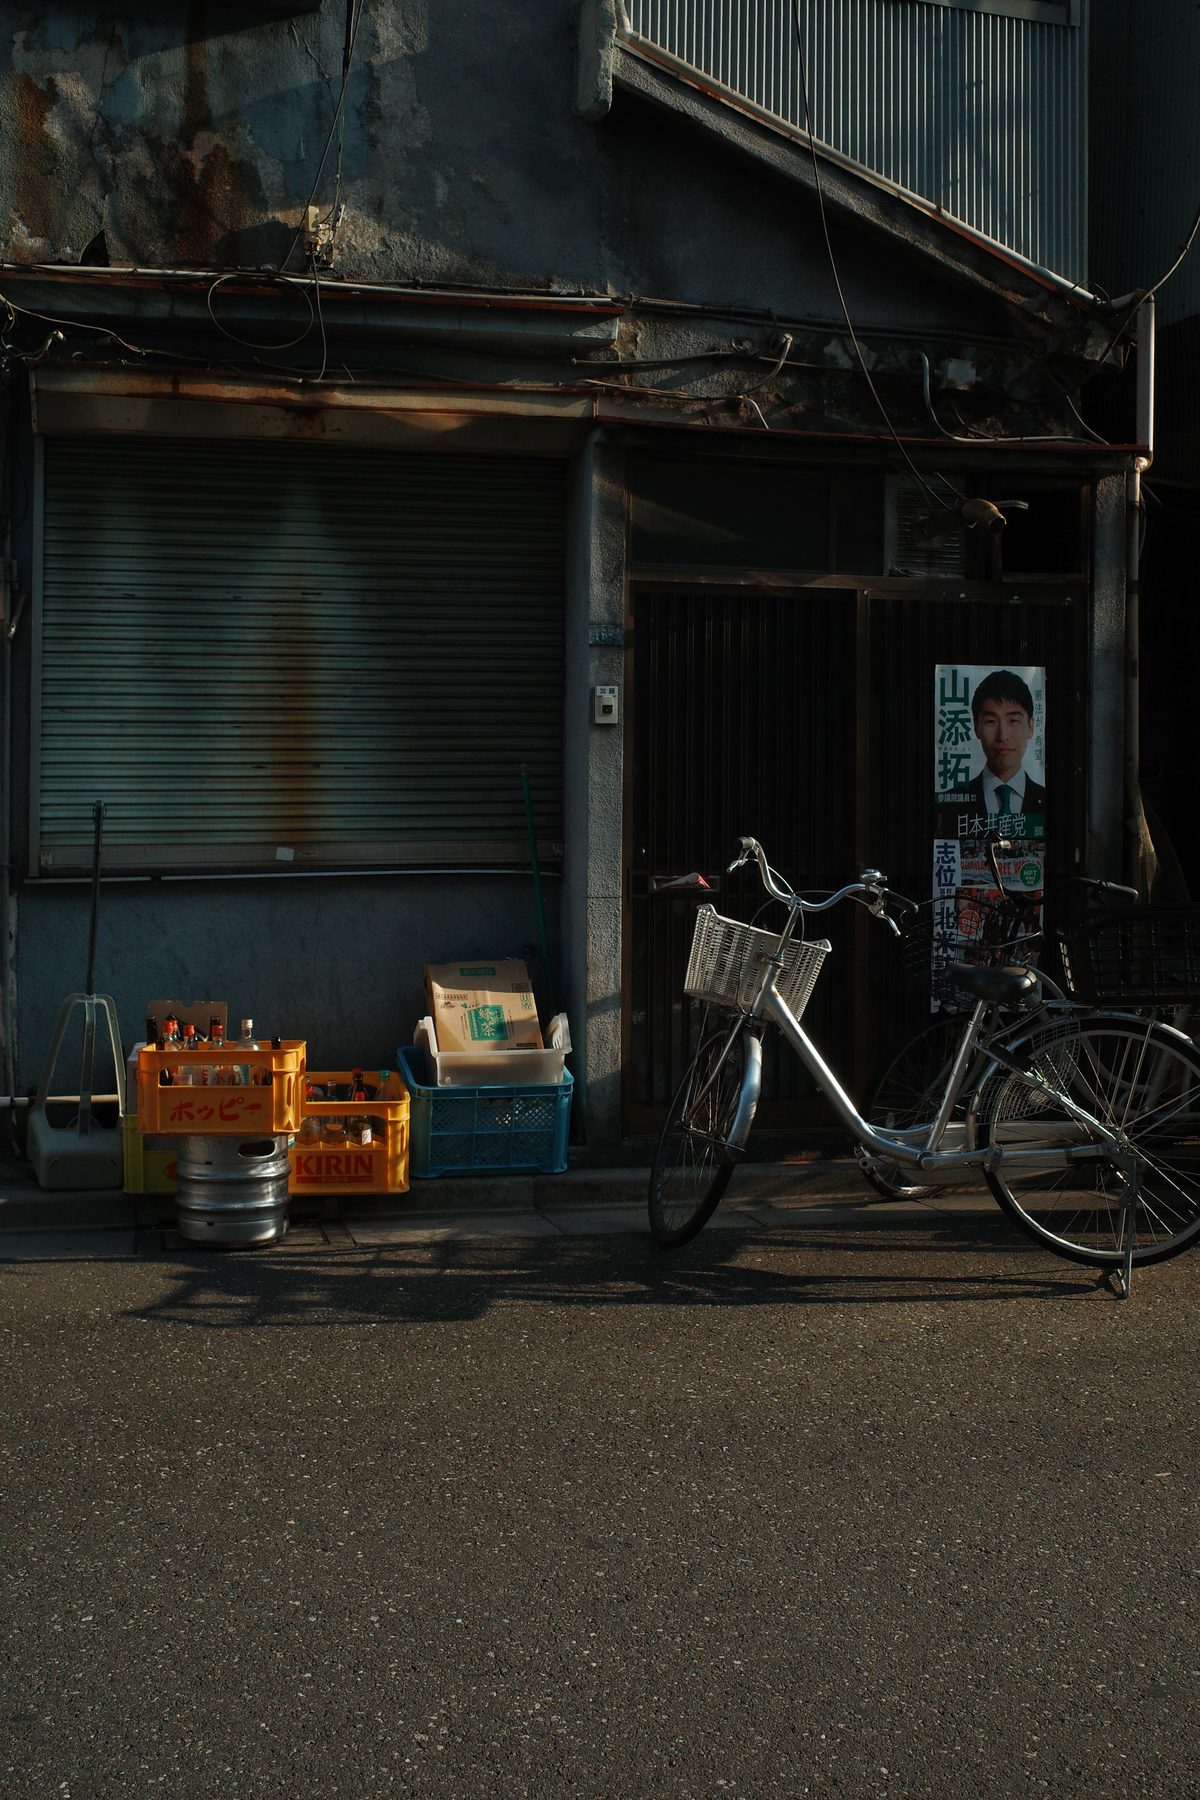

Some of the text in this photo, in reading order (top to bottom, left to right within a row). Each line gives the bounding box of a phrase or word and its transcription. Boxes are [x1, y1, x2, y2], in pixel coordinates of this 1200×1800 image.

[939, 670, 971, 789] 山添拓
[957, 812, 1026, 838] 日本共産党
[935, 842, 957, 887] 志位
[478, 1008, 496, 1037] 緑茶
[170, 1096, 262, 1122] ホッピー
[296, 1154, 373, 1175] KIRIN
